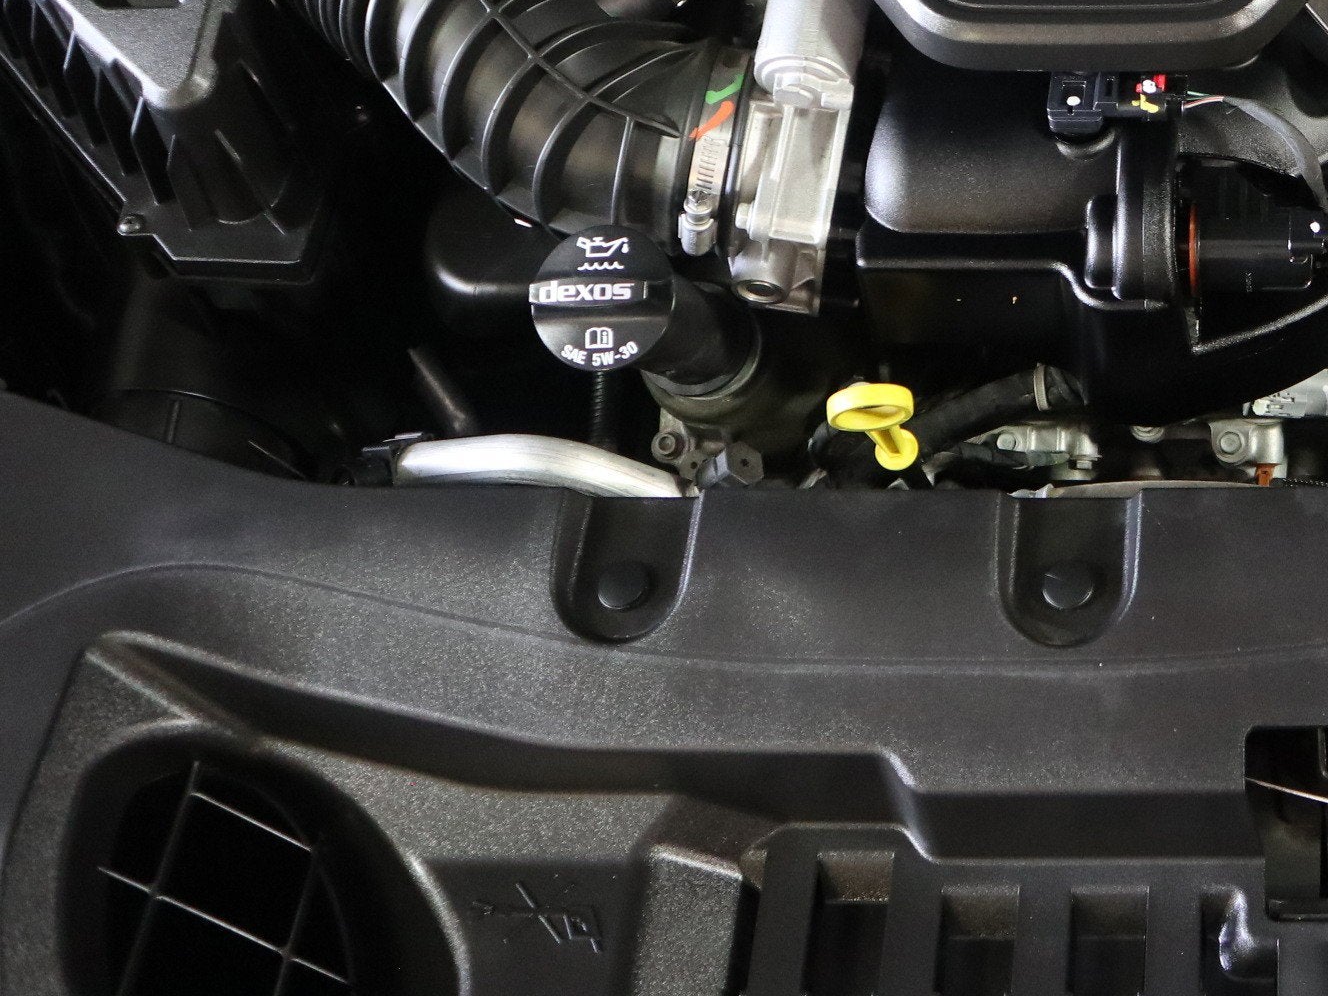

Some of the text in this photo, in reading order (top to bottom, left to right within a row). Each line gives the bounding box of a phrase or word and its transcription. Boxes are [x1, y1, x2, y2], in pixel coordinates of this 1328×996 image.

[538, 280, 633, 303] dexos
[561, 341, 639, 366] SAE 5W-30
